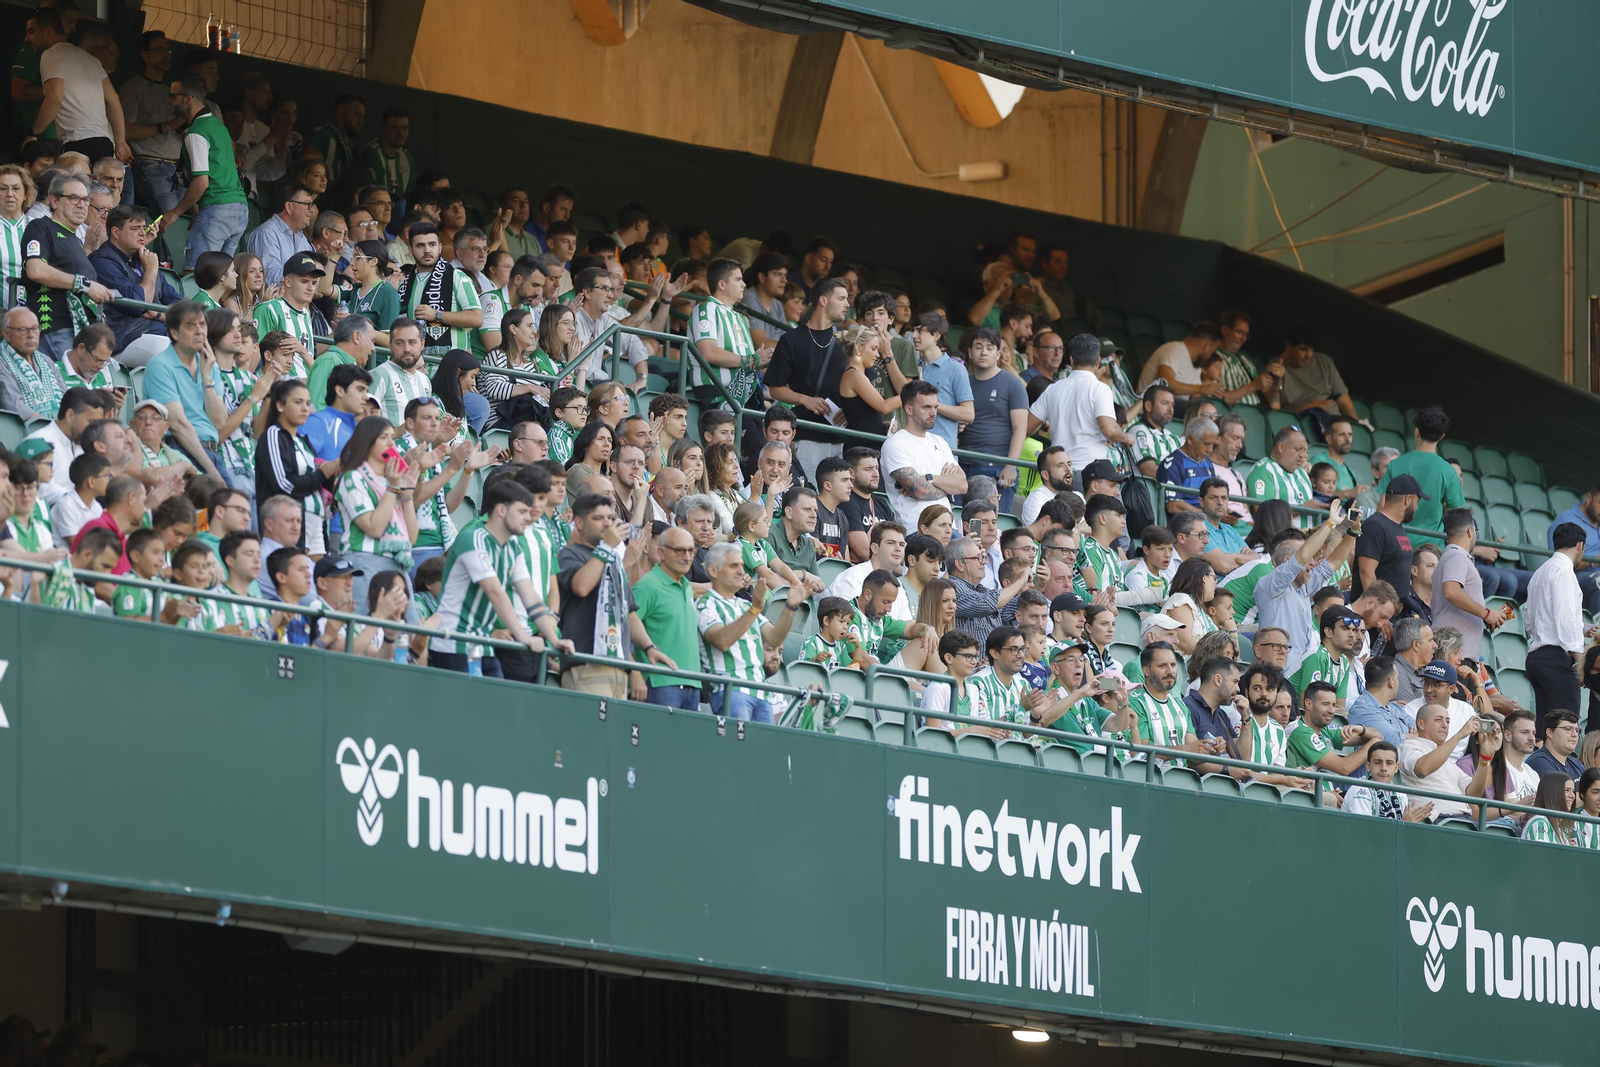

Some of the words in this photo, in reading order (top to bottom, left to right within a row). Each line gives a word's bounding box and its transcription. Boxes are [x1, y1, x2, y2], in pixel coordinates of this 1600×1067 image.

[394, 381, 403, 394] 3
[407, 748, 599, 875] hummel
[894, 775, 1143, 894] finetwork
[946, 906, 1009, 986] FIBRA
[1011, 915, 1026, 987] Y
[1029, 909, 1095, 997] MÓVIL
